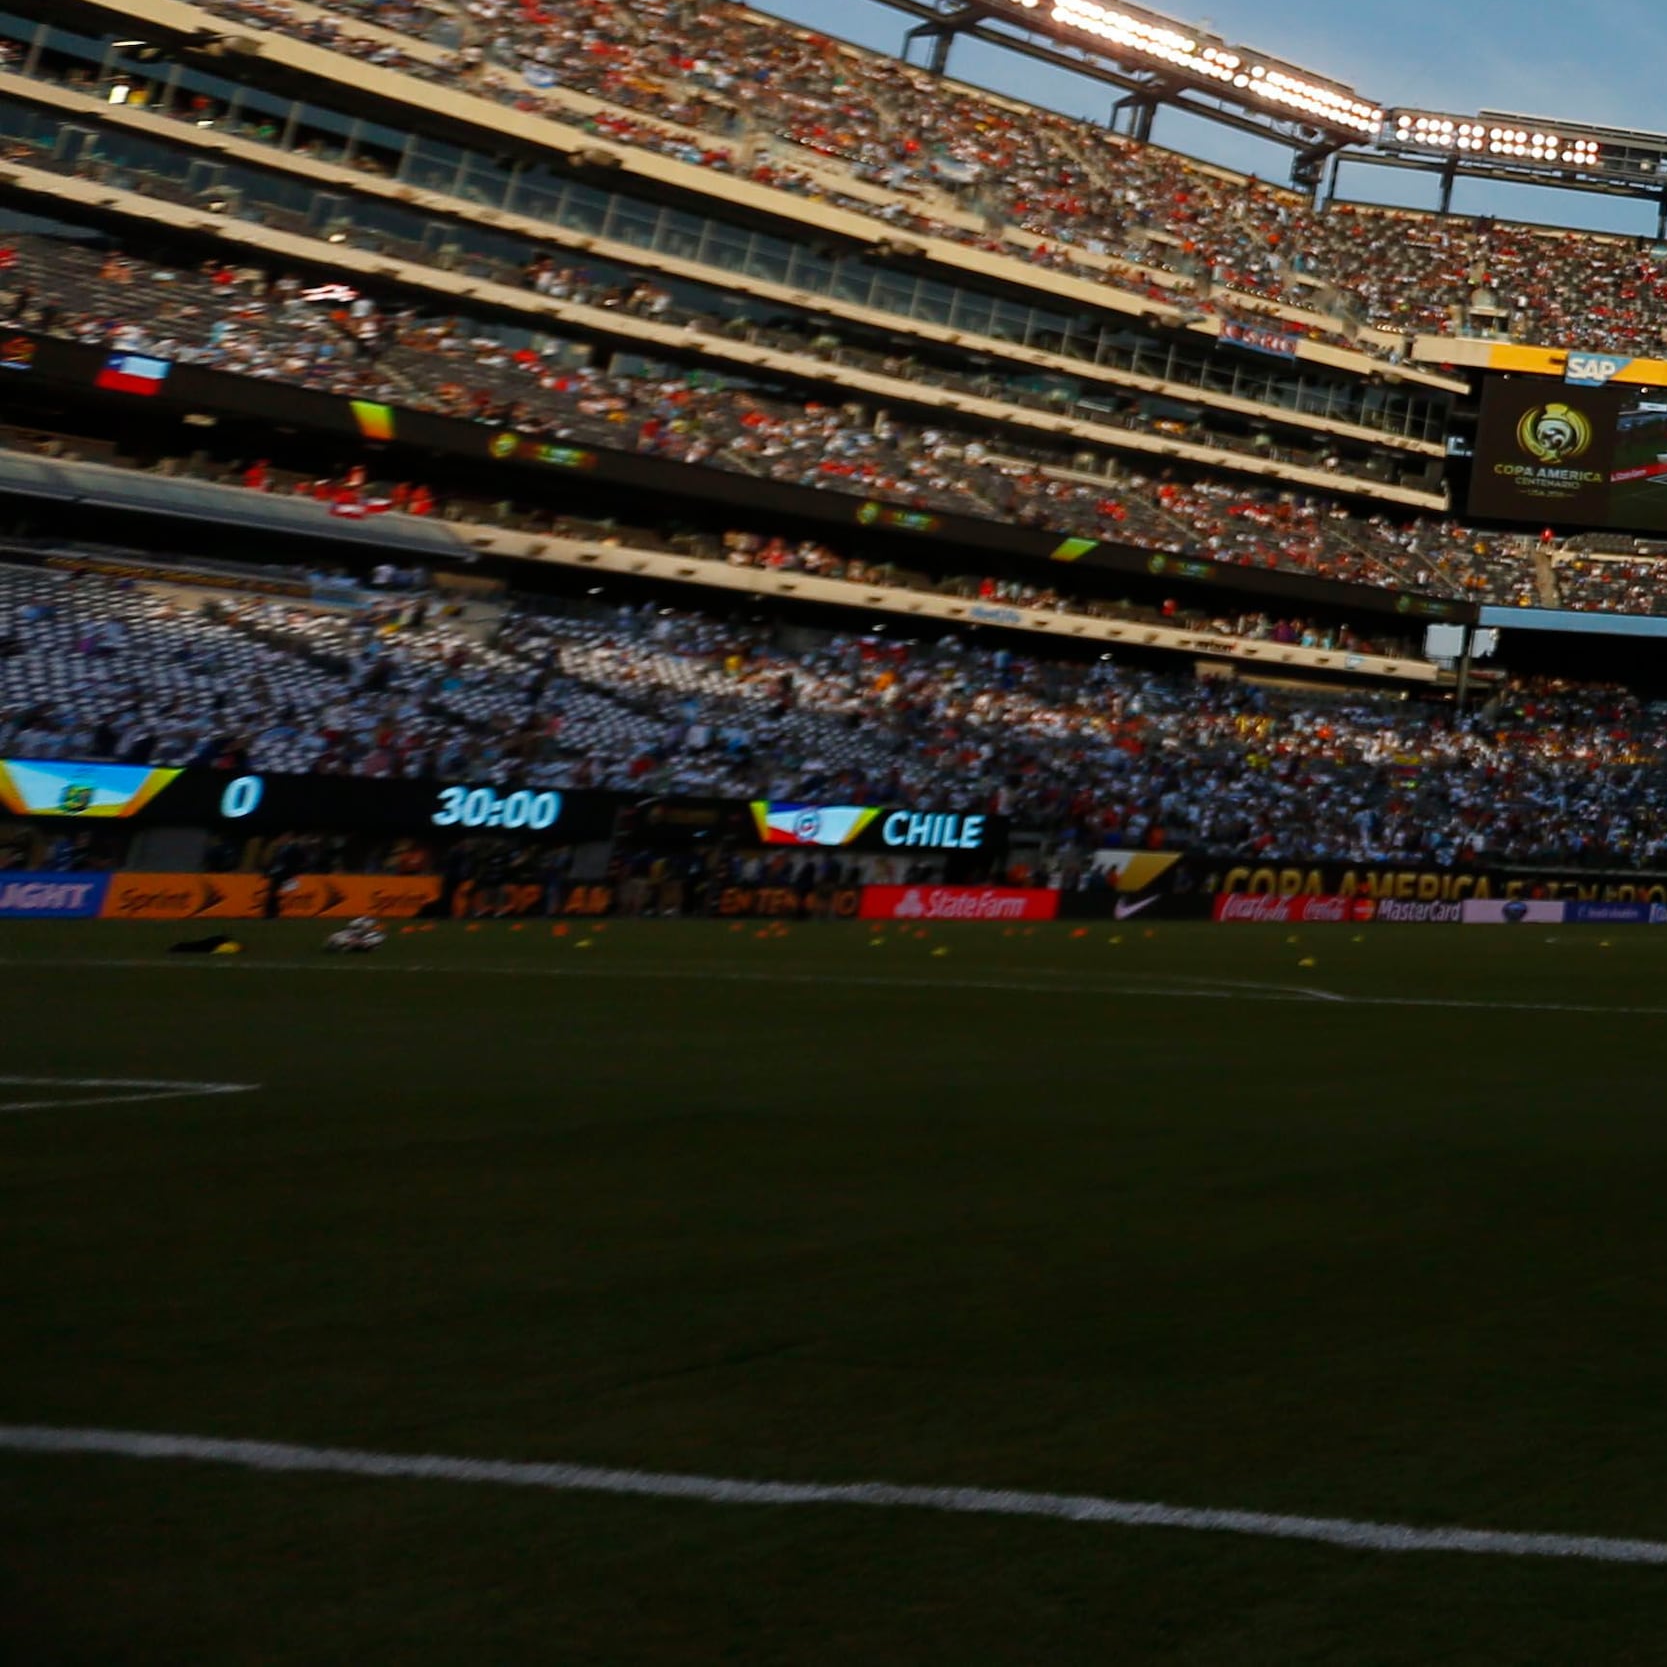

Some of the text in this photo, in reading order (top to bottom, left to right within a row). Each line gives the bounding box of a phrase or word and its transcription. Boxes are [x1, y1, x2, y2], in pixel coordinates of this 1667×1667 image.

[1566, 358, 1615, 380] SAP
[1493, 464, 1535, 476] COPA
[1536, 467, 1603, 483] AMERICA
[220, 774, 265, 819] 0
[431, 785, 564, 831] 30:00
[881, 809, 987, 849] CHILE
[117, 886, 192, 912] Sprint
[1376, 899, 1462, 922] MasterCard
